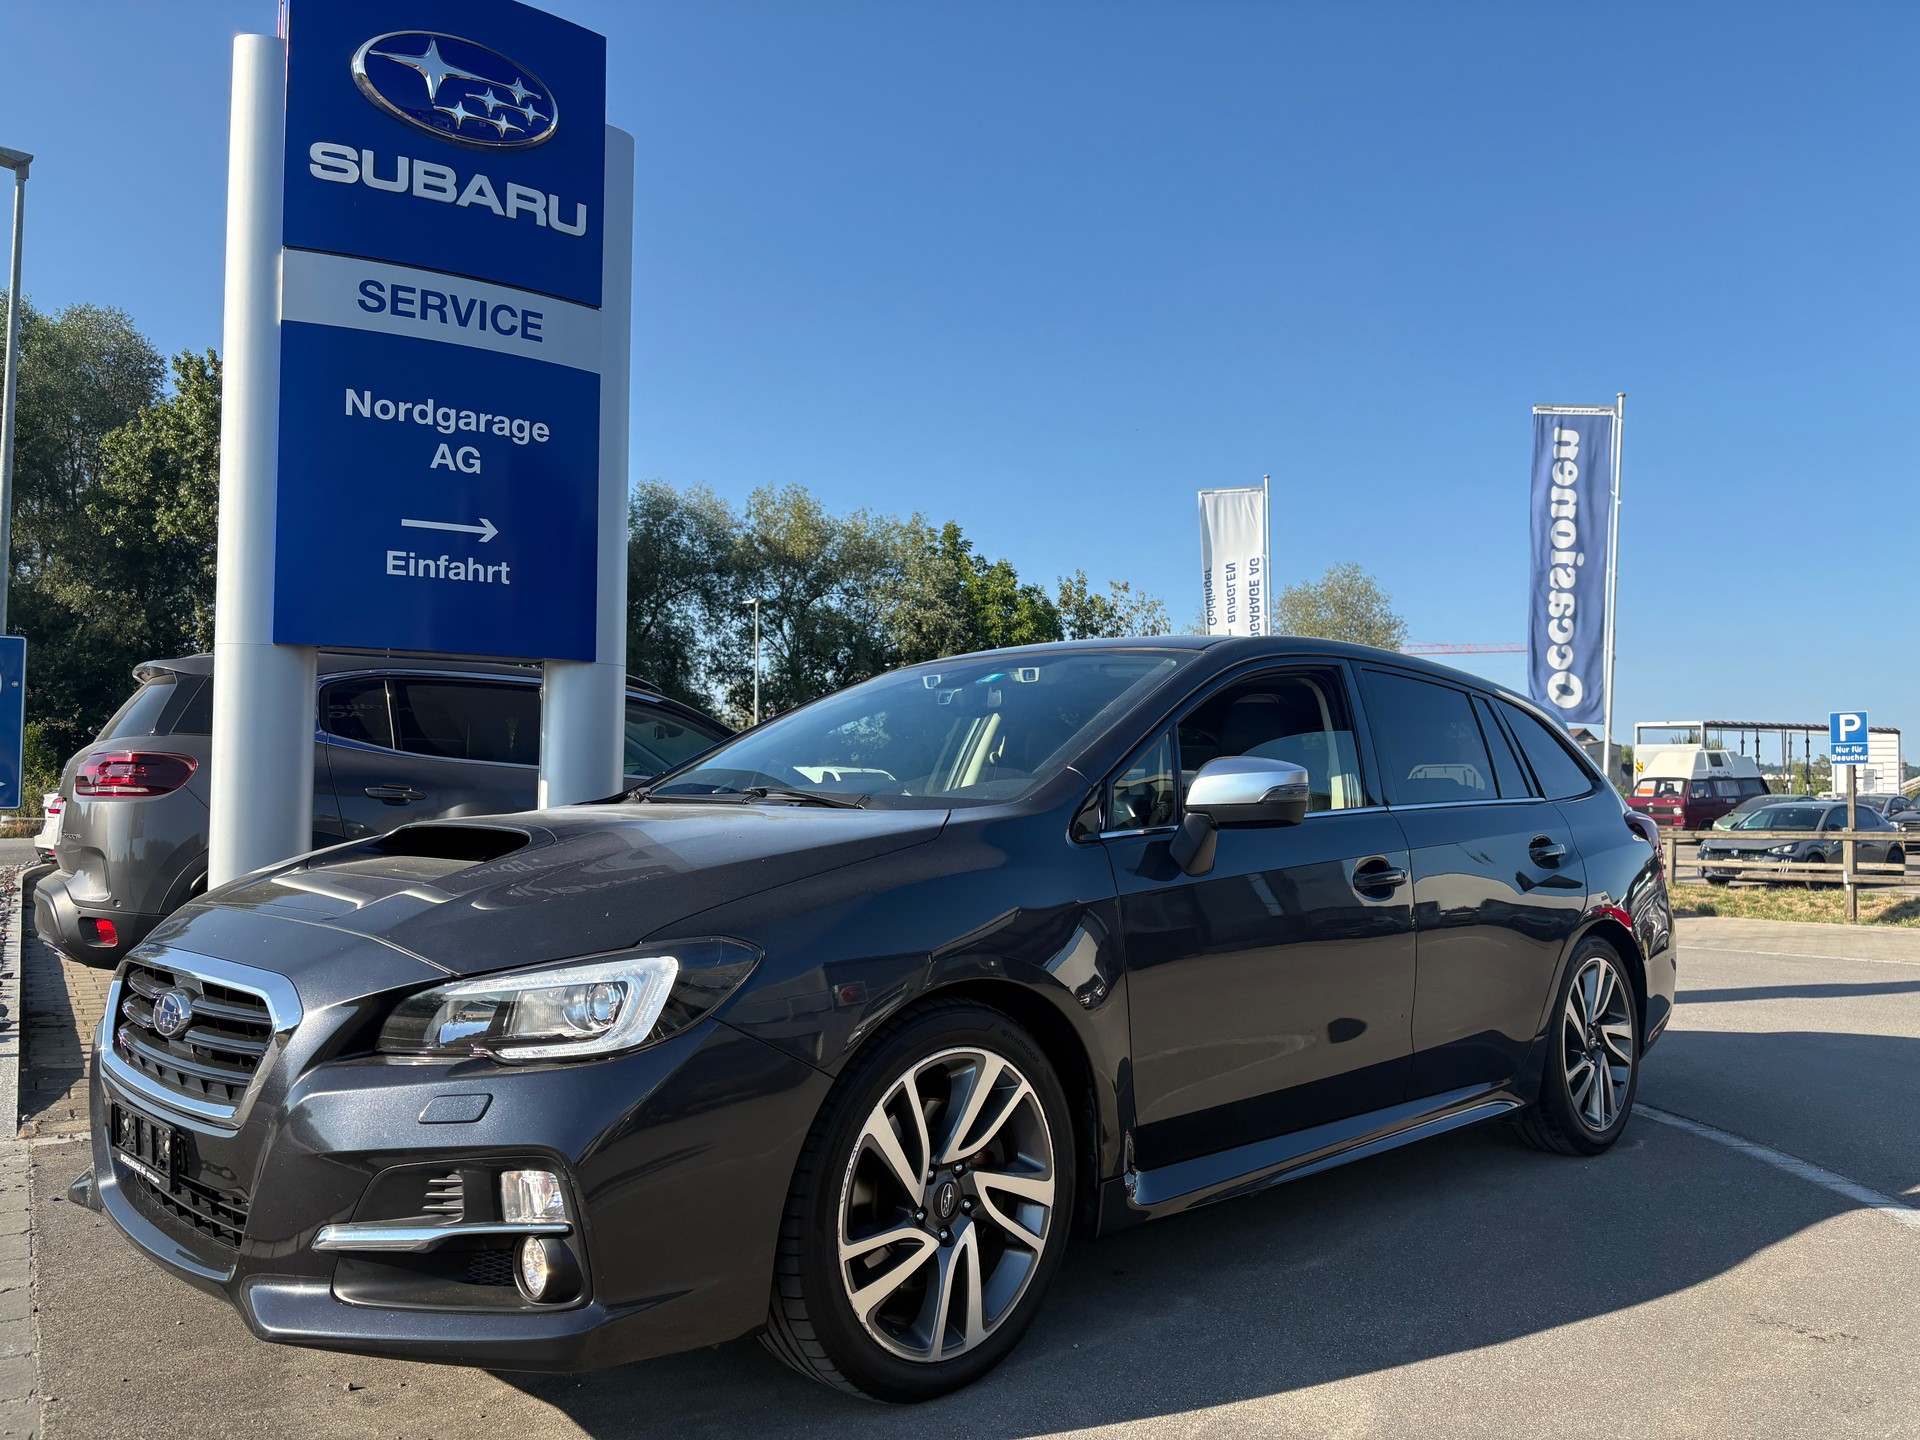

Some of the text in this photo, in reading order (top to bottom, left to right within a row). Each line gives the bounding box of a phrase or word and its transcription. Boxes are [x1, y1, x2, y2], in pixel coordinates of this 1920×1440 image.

[309, 142, 588, 237] SUBARU
[357, 280, 544, 343] SERVICE
[344, 388, 551, 444] Nordgarage
[430, 444, 482, 475] AG
[385, 550, 511, 586] Einfahrt
[1839, 714, 1861, 742] P
